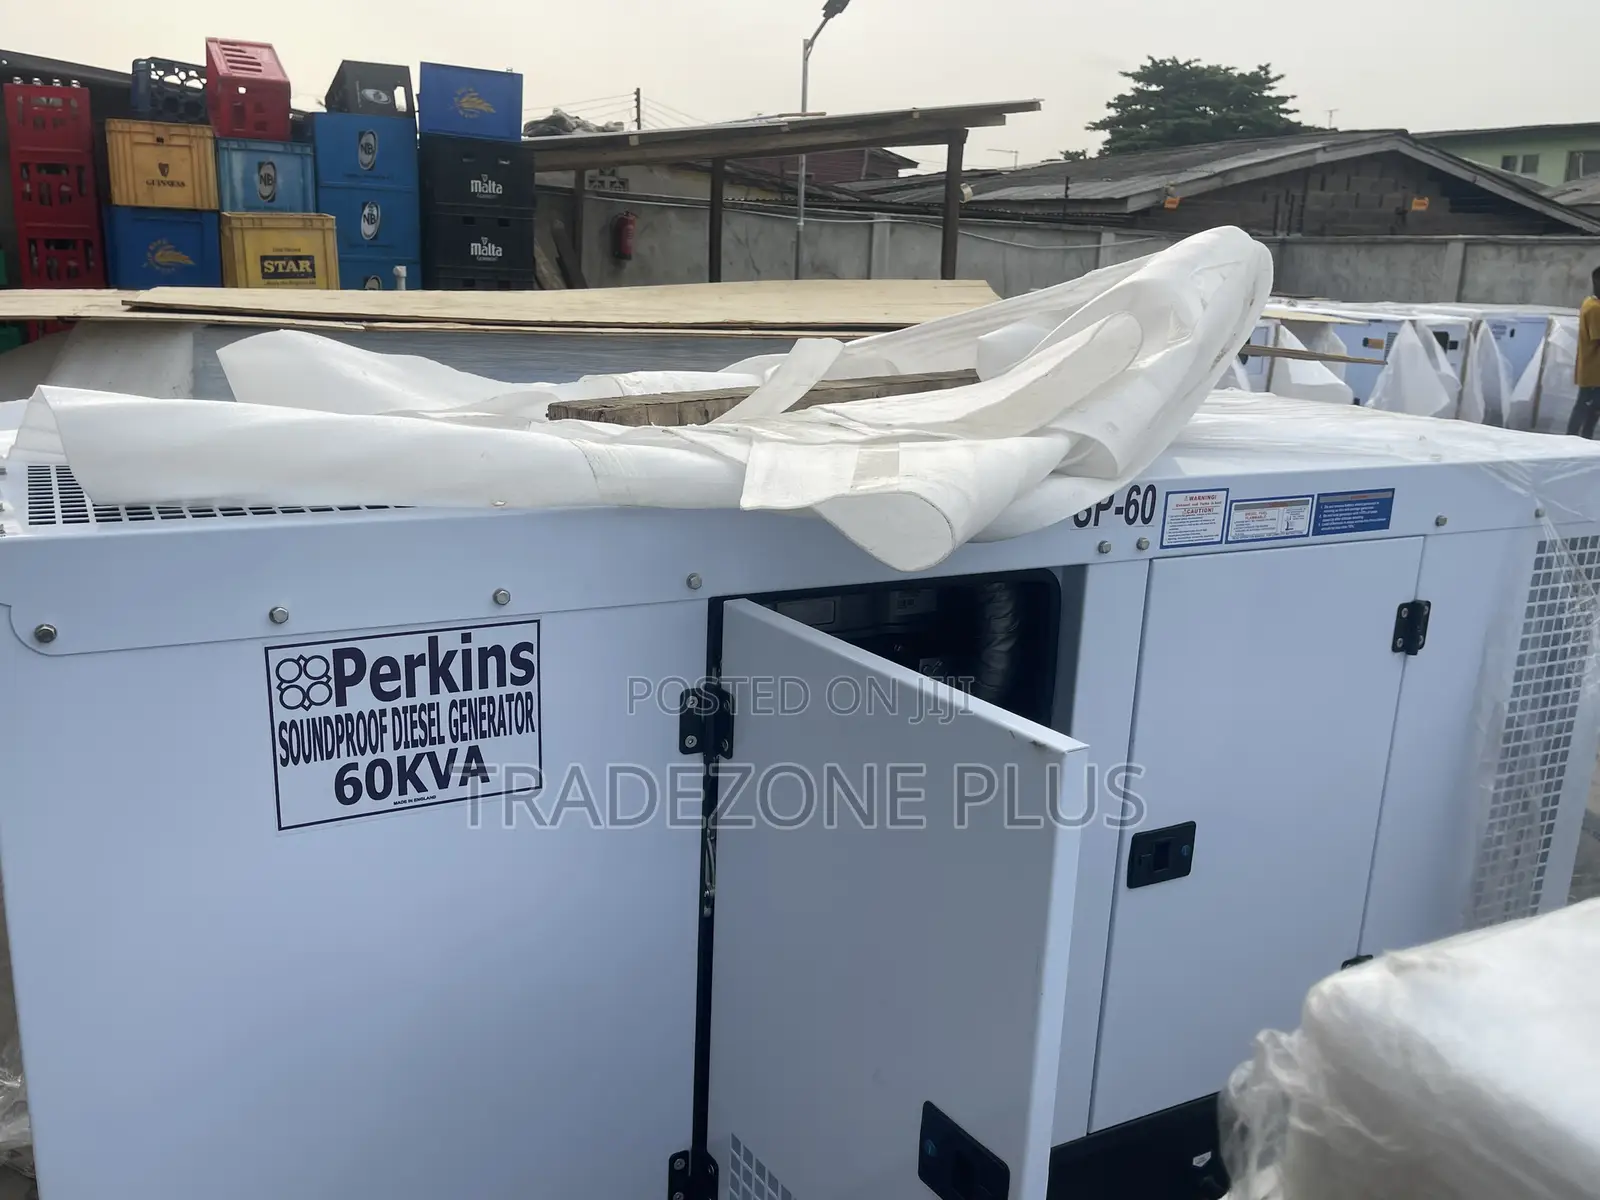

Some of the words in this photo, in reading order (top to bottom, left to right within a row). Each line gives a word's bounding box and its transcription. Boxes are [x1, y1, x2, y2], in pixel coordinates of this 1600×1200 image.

[145, 179, 186, 188] GUINNESS
[363, 213, 376, 225] NB
[263, 260, 313, 273] STAR
[332, 632, 536, 708] Perkins
[278, 708, 388, 768] SOUNDPROOF
[392, 702, 445, 752] DIESEL
[448, 691, 536, 743] GENERATOR
[334, 745, 491, 806] 60KVA
